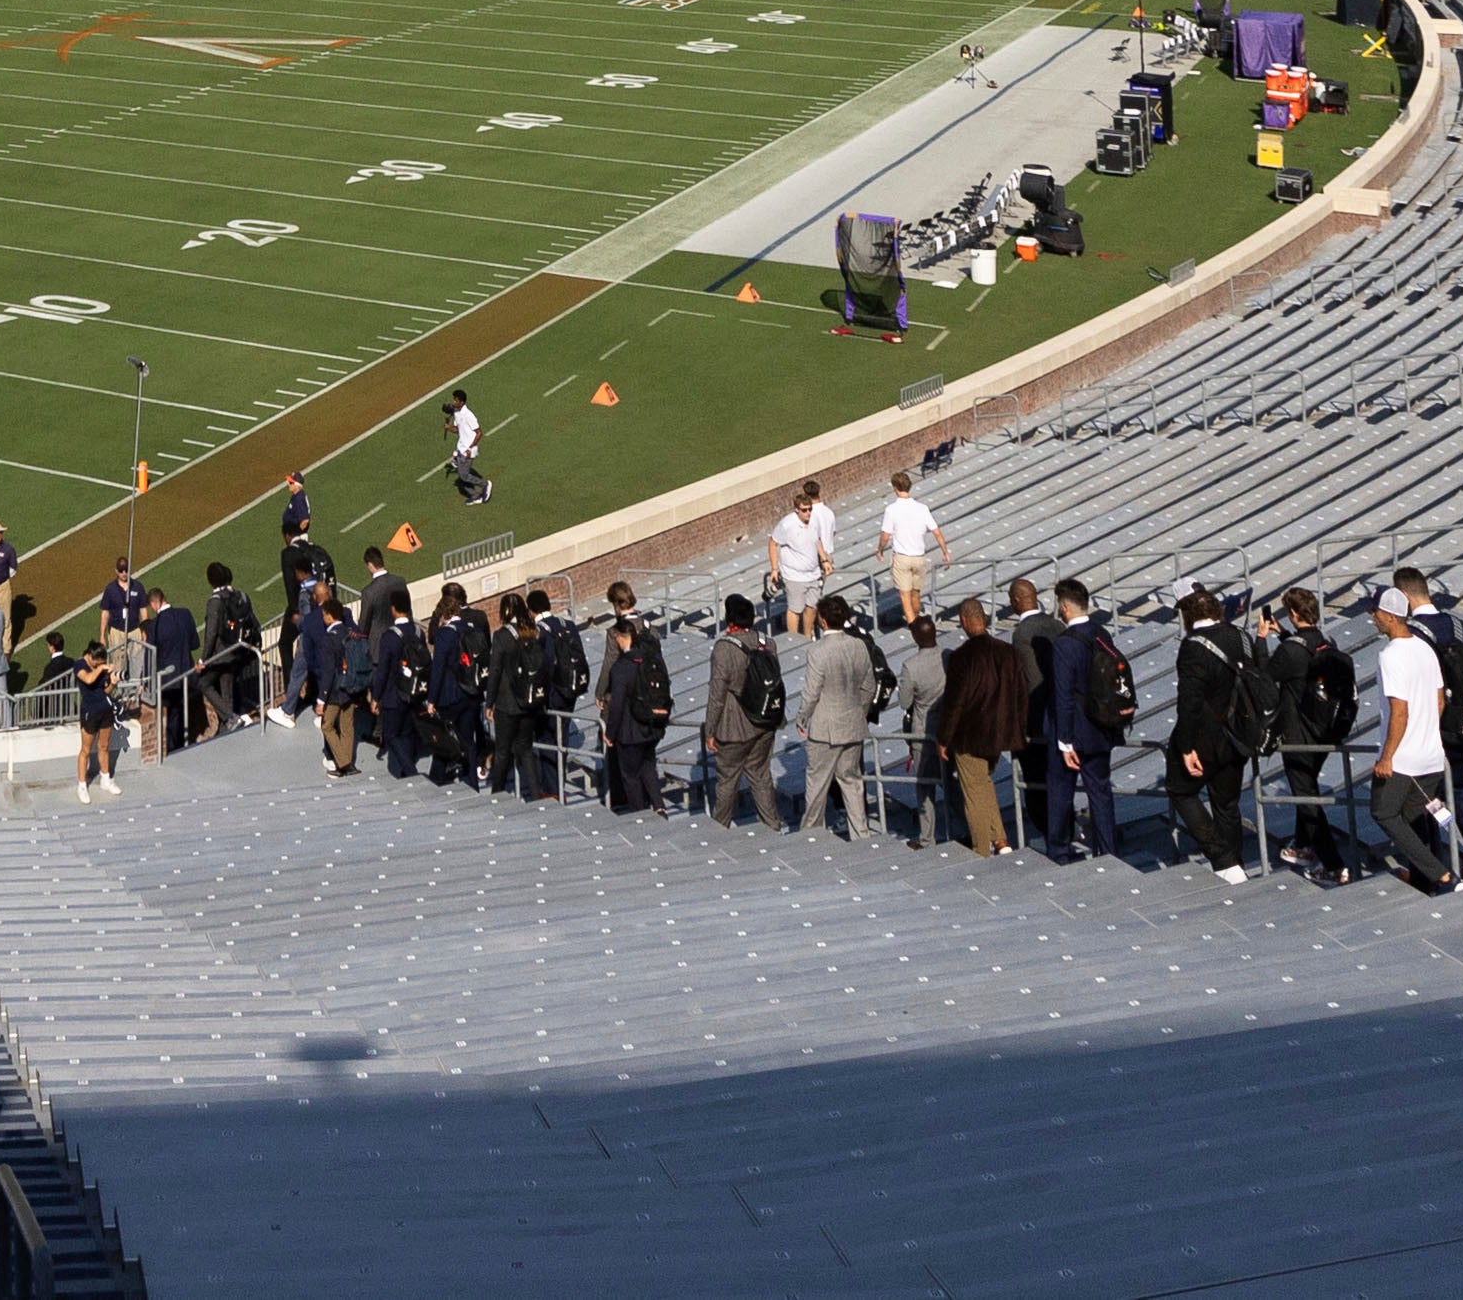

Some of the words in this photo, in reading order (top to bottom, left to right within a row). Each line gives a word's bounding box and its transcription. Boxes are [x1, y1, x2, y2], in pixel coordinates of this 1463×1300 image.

[676, 41, 739, 54] 40
[585, 73, 659, 89] 50
[487, 112, 563, 130] 40
[357, 159, 446, 181] 30
[198, 219, 299, 247] 20
[4, 295, 111, 324] 10
